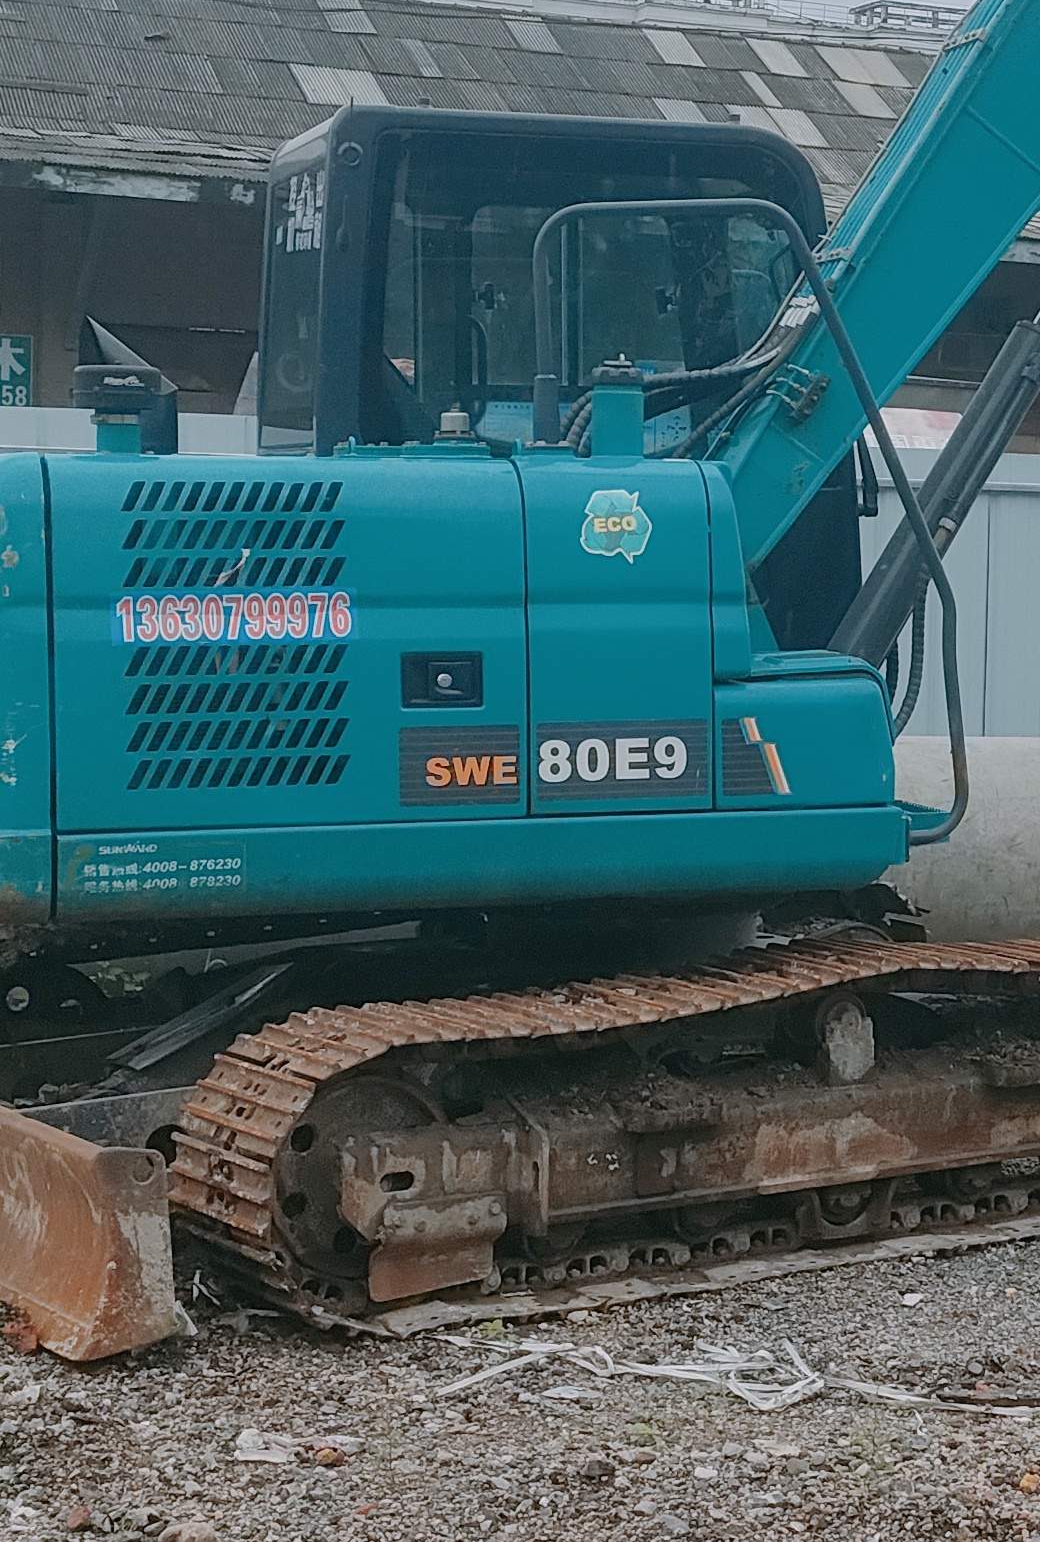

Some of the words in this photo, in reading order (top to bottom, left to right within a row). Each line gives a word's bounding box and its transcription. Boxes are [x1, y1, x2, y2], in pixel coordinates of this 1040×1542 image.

[593, 515, 637, 533] ECO
[116, 591, 352, 643] 13630799976
[425, 755, 518, 787] SWE
[538, 736, 688, 783] 80E9
